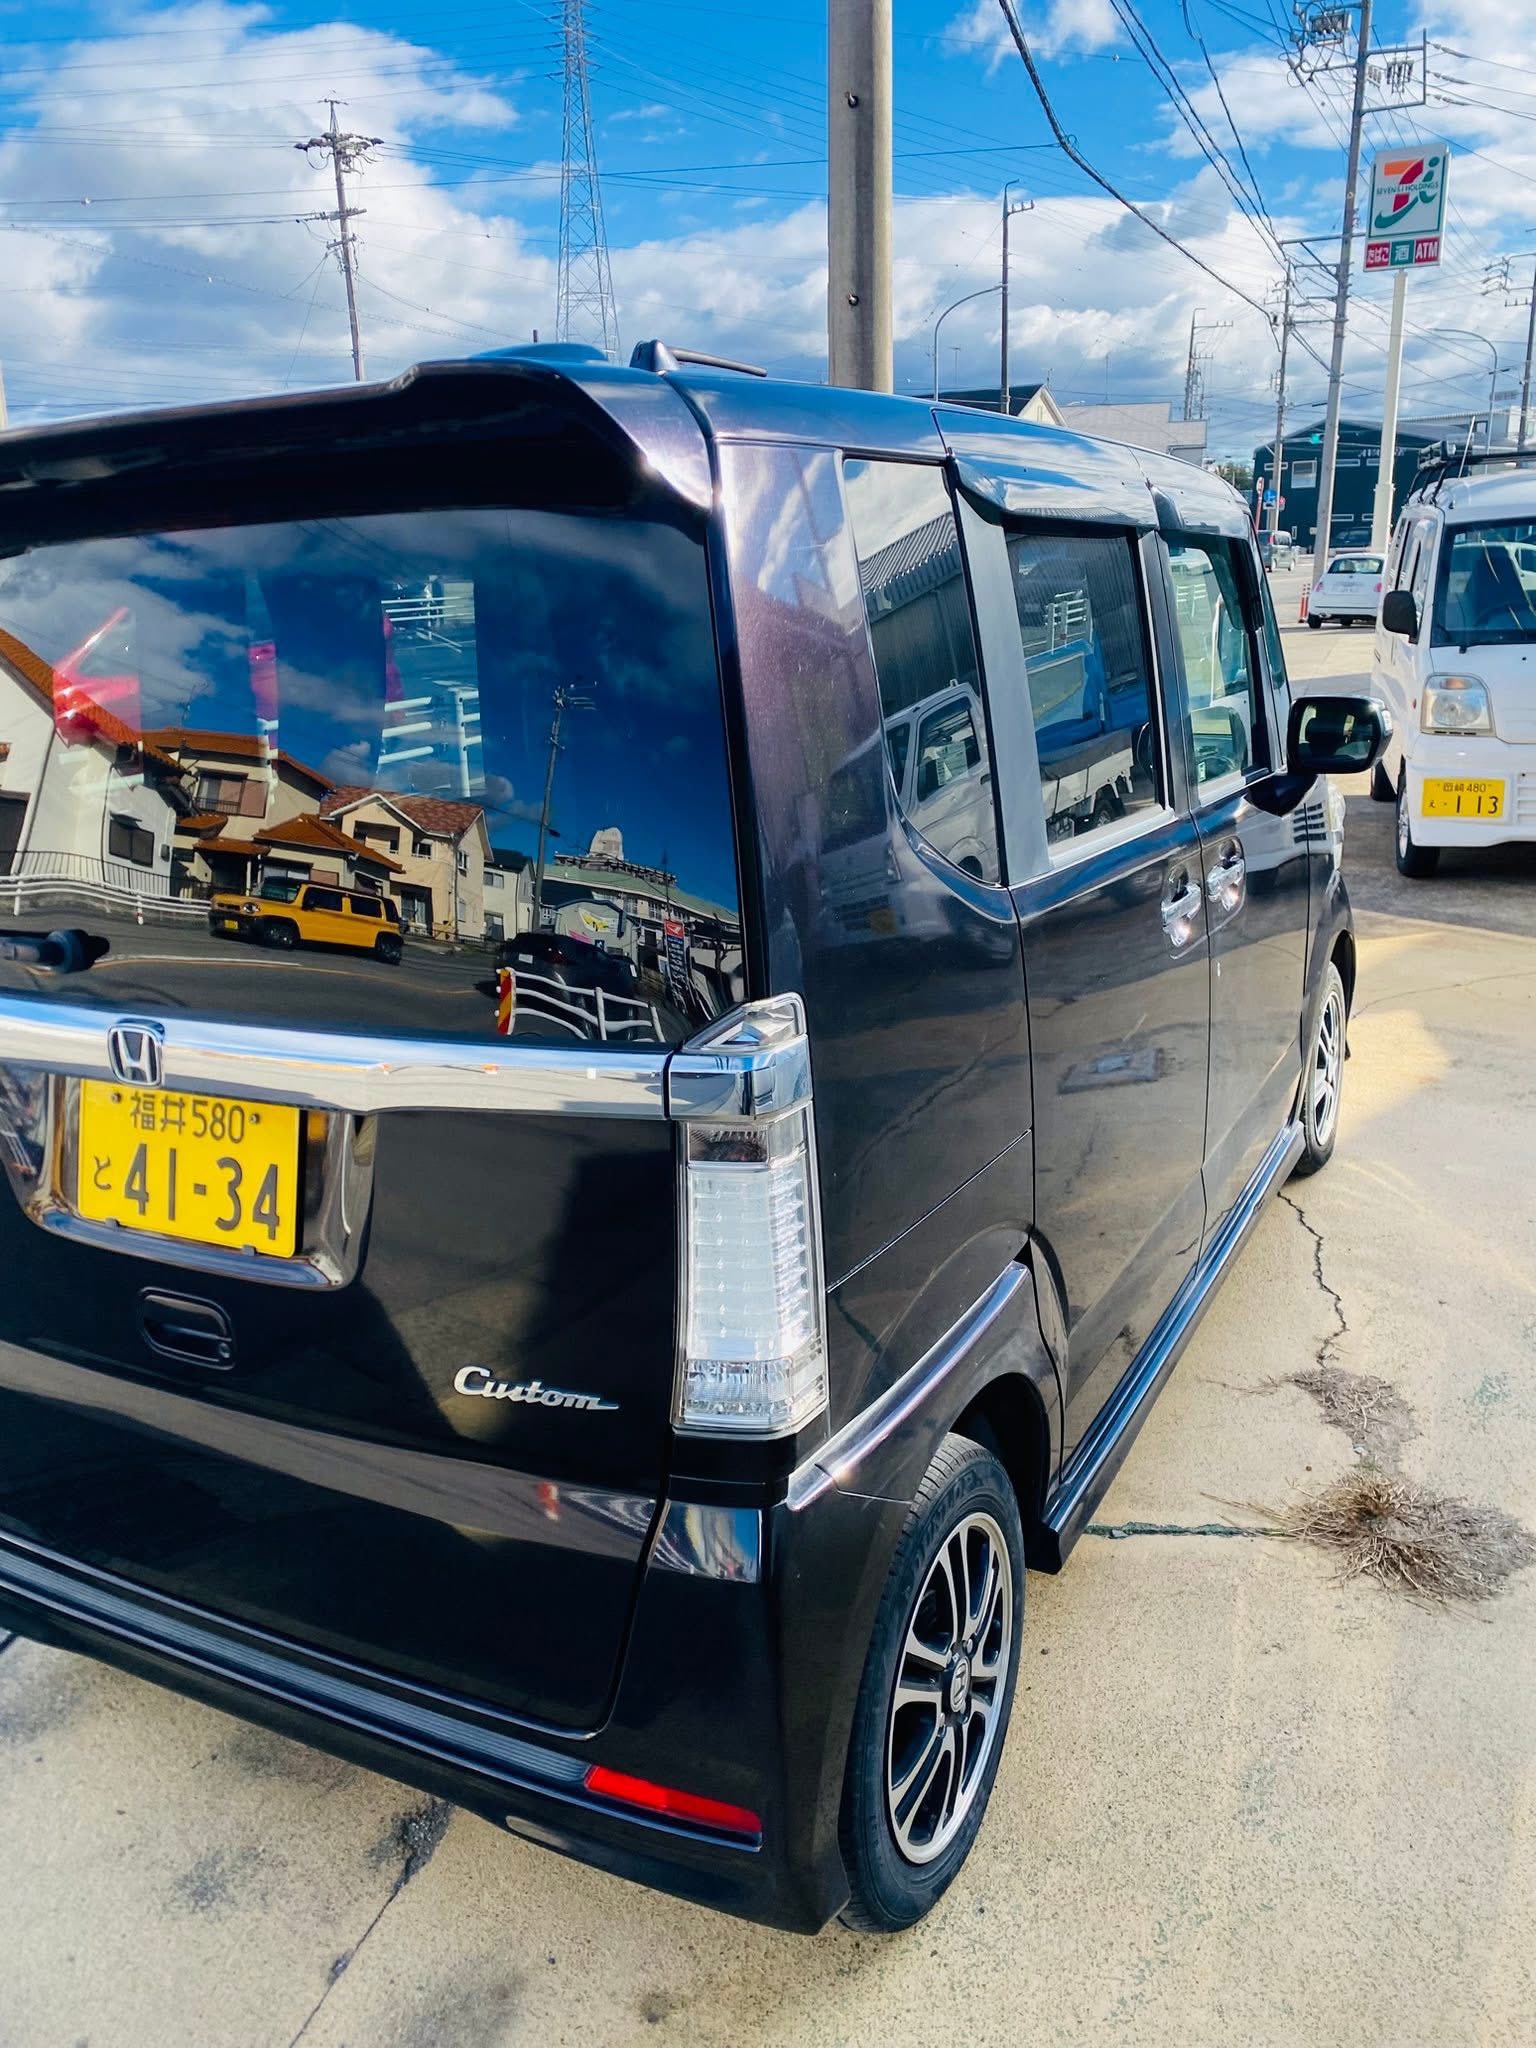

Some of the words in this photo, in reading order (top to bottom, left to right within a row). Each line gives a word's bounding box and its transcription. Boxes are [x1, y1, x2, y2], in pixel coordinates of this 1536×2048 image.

[1395, 244, 1410, 261] 酒
[1415, 241, 1438, 259] ATM
[94, 1155, 112, 1190] と
[124, 1143, 280, 1241] 41-34
[454, 1365, 619, 1411] Custom
